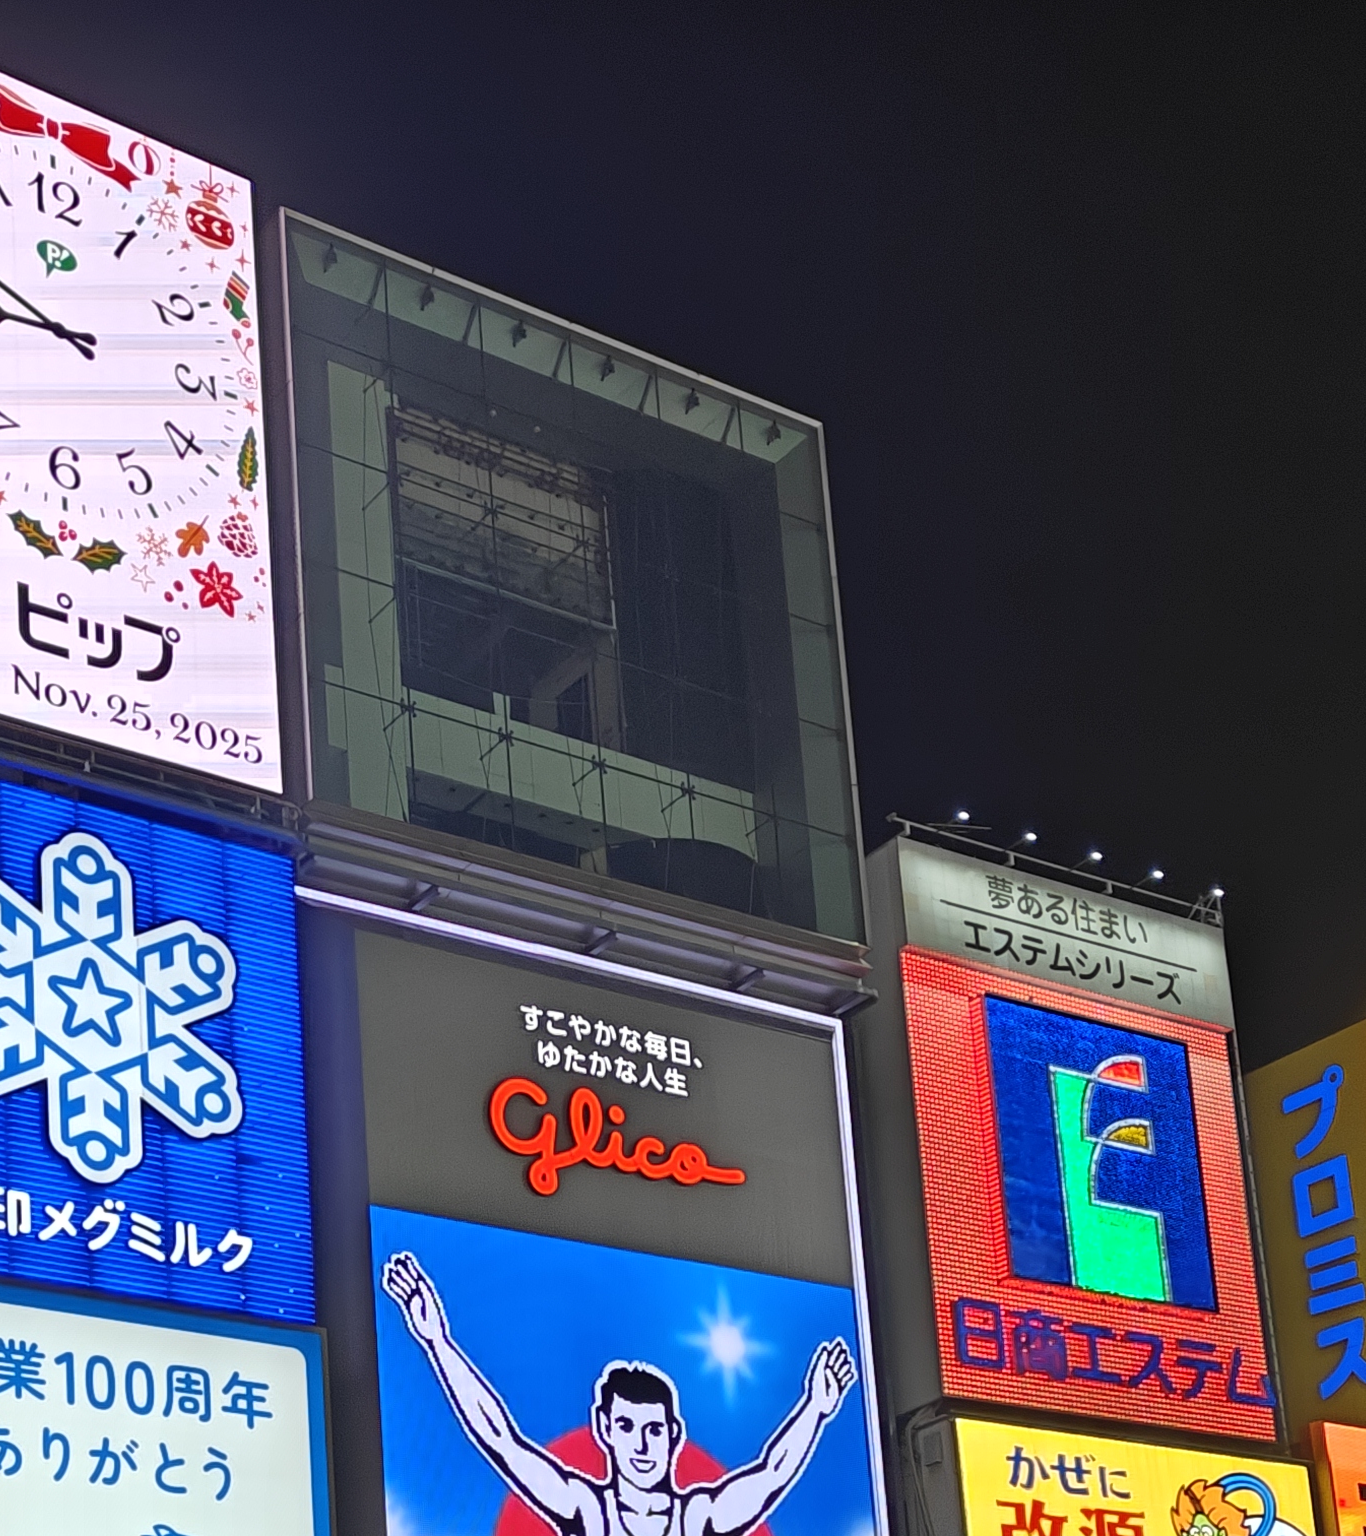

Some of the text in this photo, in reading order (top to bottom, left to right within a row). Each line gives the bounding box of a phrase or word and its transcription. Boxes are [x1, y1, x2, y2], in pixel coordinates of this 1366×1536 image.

[29, 172, 82, 227] 12
[114, 230, 137, 260] 1
[151, 294, 195, 326] 2
[174, 363, 217, 401] 3
[164, 420, 203, 460] 4
[48, 447, 82, 491] 6
[116, 450, 153, 495] 5
[17, 581, 181, 682] ピップ
[11, 664, 263, 764] Nov. 25, 2025
[985, 874, 1149, 945] 夢ある住まい
[964, 919, 1181, 1005] エステムシリーズ
[520, 1004, 703, 1068] すこやかな毎日、
[537, 1040, 690, 1097] ゆたかな人生
[489, 1076, 746, 1195] Glico
[954, 1297, 1278, 1408] 日商エステム
[1005, 1445, 1132, 1499] かぜに
